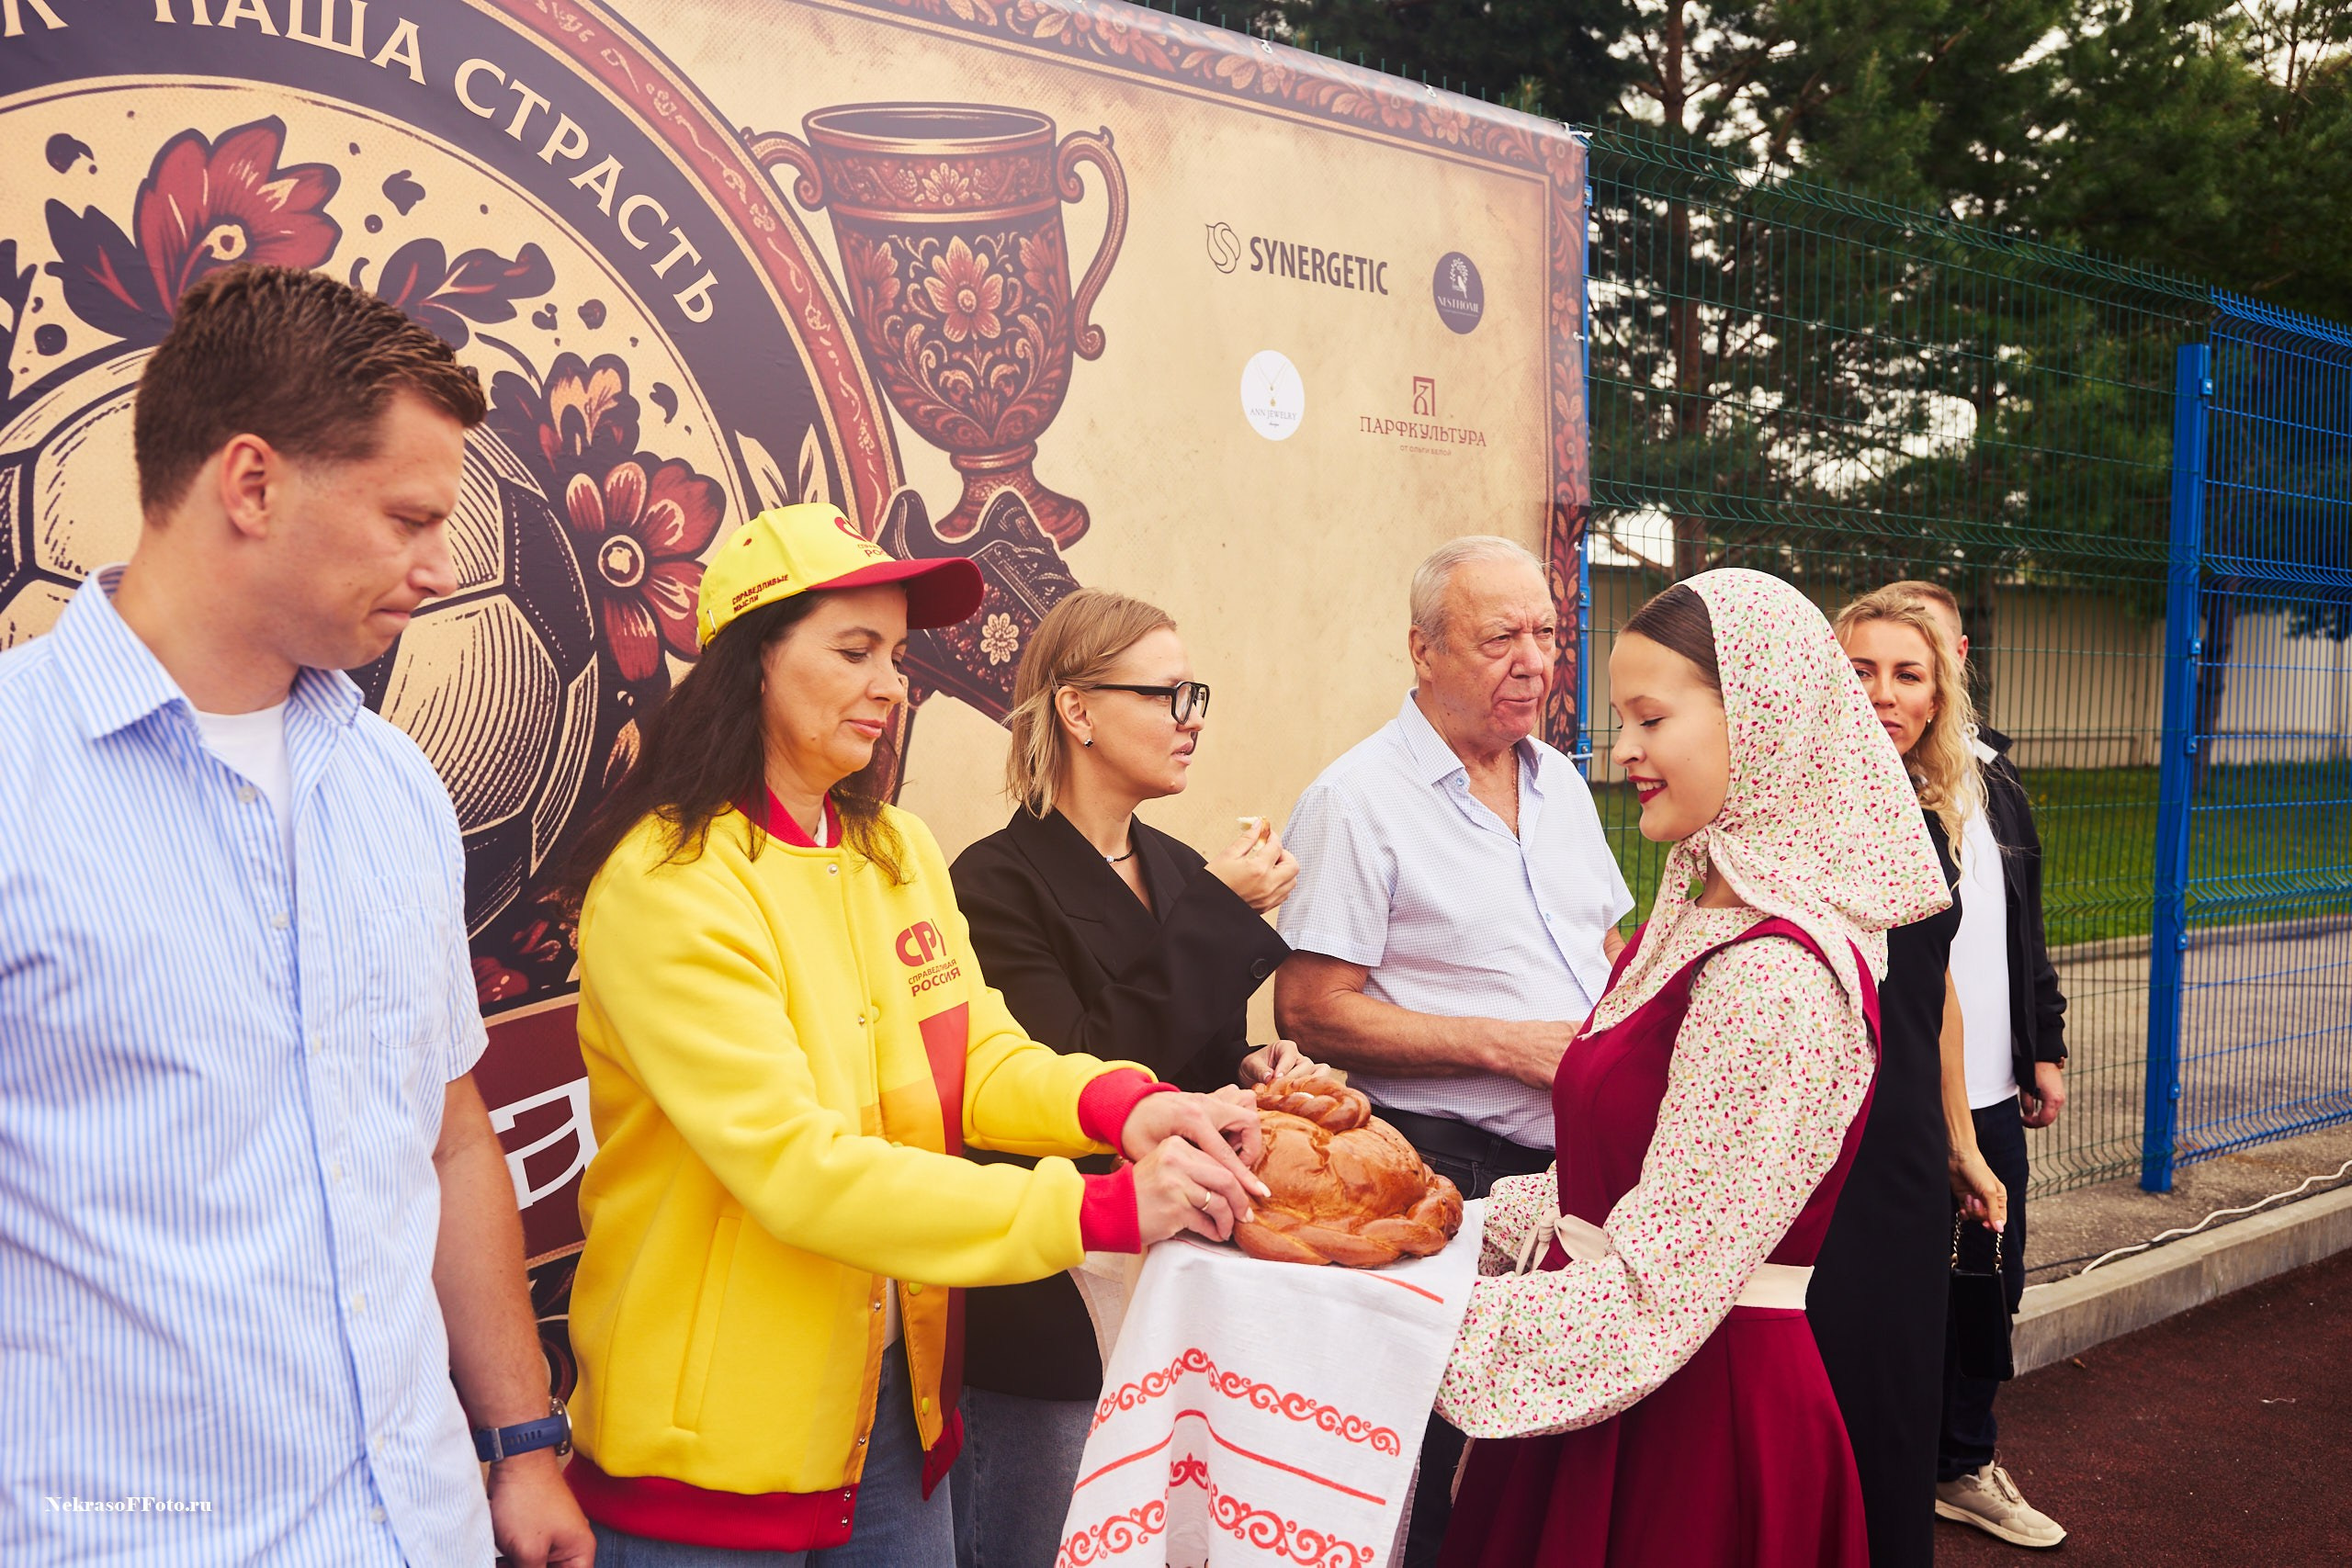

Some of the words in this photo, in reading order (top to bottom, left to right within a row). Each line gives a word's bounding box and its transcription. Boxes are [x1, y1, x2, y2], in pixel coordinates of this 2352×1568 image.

[454, 58, 719, 323] СТРАСТЬ
[1250, 235, 1389, 297] SYNERGETIC
[1360, 415, 1487, 447] ПАРФКУЛЬТУРА
[731, 574, 788, 605] СПРАВЕДЛИВЫЕ
[733, 594, 759, 614] МЫСЛИ
[910, 966, 962, 998] РОССИЯ
